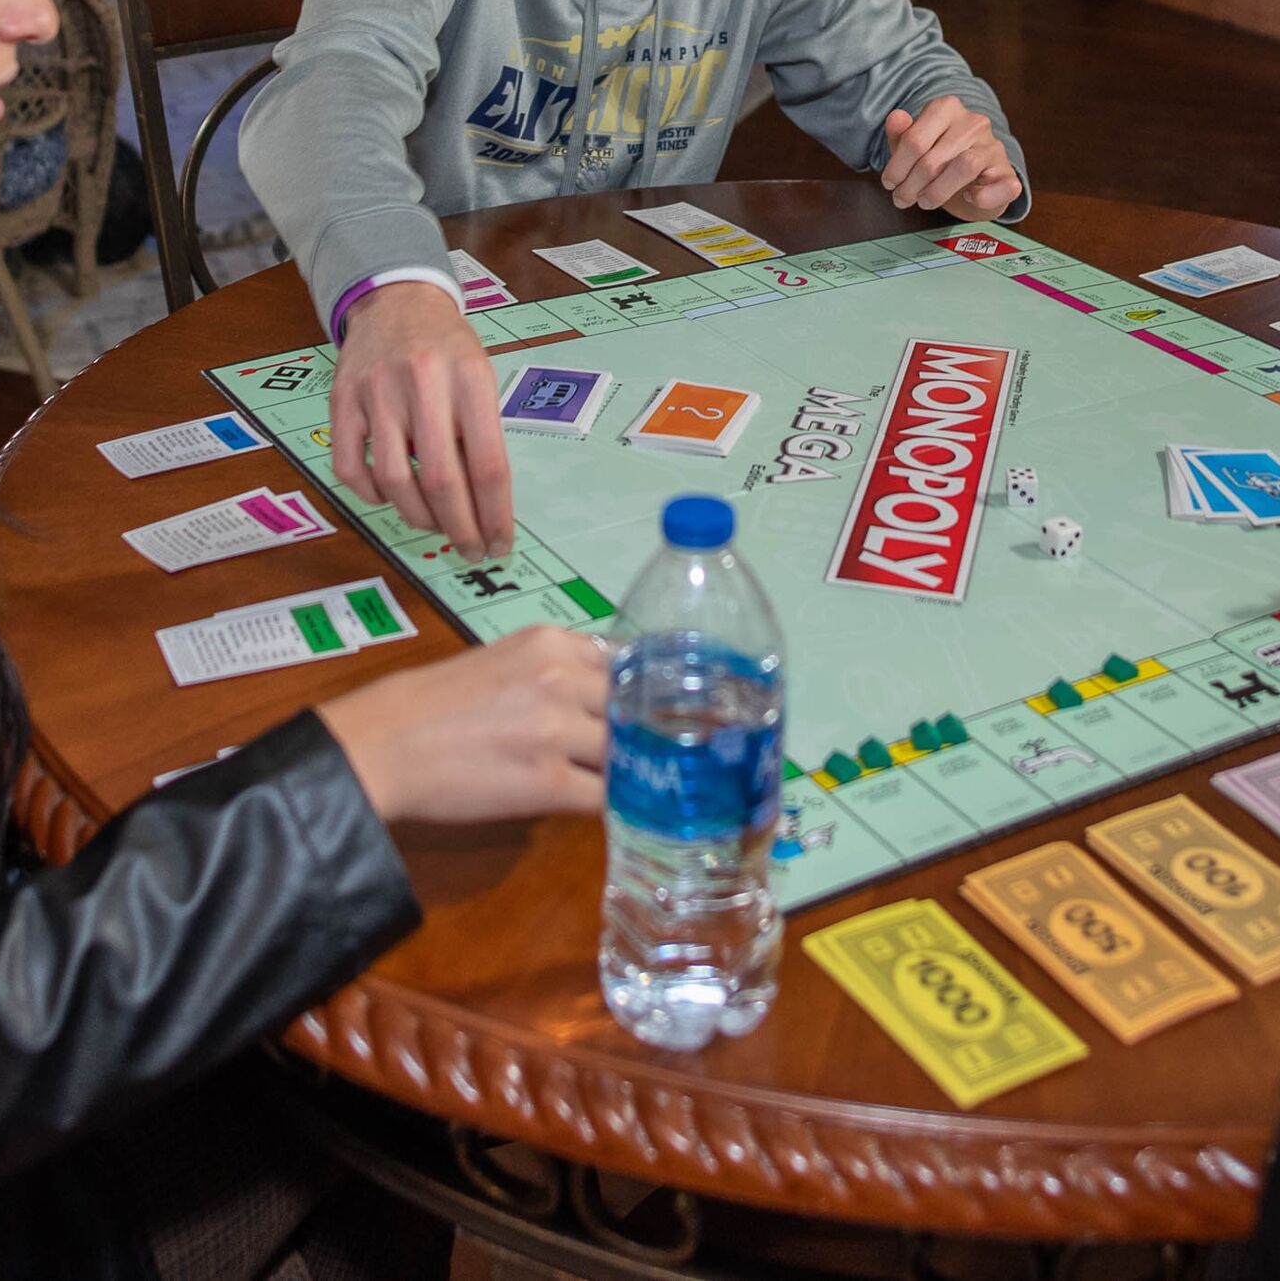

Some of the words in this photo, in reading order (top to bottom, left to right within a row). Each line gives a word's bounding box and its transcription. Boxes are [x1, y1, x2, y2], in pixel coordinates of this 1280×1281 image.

[260, 366, 314, 391] GO
[868, 385, 886, 397] The
[765, 386, 872, 484] MEGA
[857, 347, 999, 589] MONOPOLY
[1183, 853, 1251, 899] 100
[1063, 900, 1132, 955] 500
[909, 958, 989, 1025] 1000
